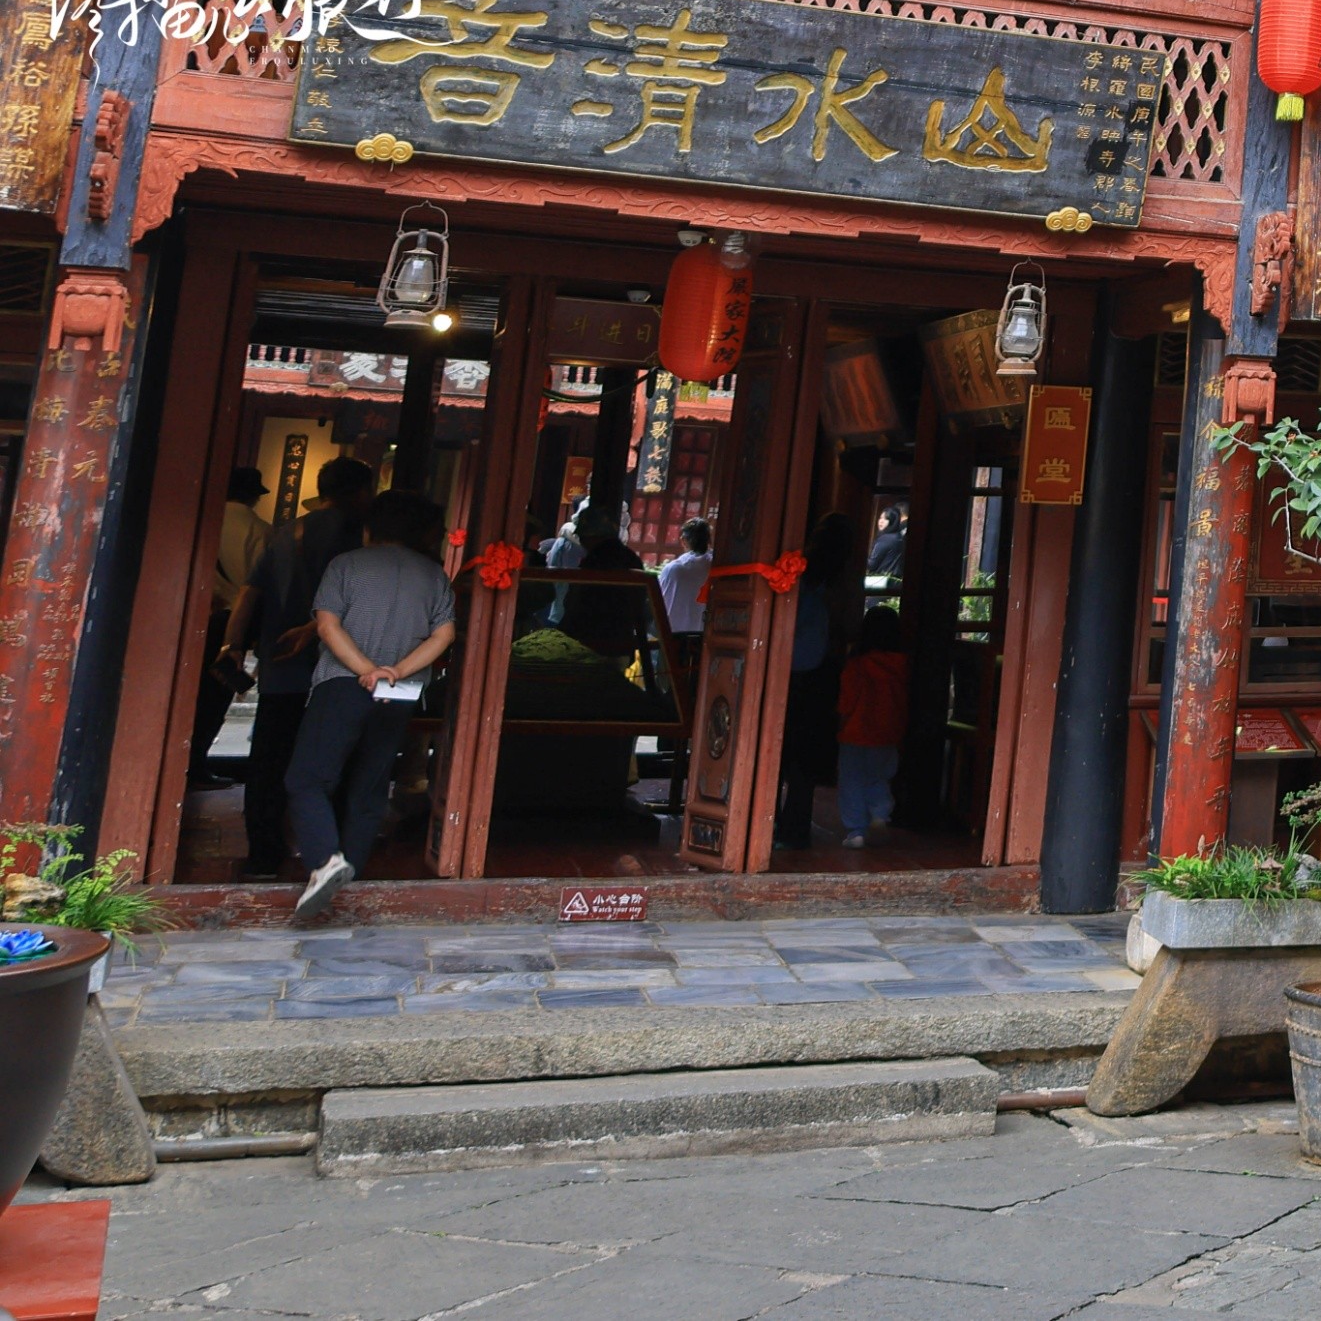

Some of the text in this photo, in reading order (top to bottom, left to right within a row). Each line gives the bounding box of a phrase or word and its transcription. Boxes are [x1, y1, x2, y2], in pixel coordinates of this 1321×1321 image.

[592, 893, 644, 906] 小心台阶
[592, 906, 643, 917] Watch your step
